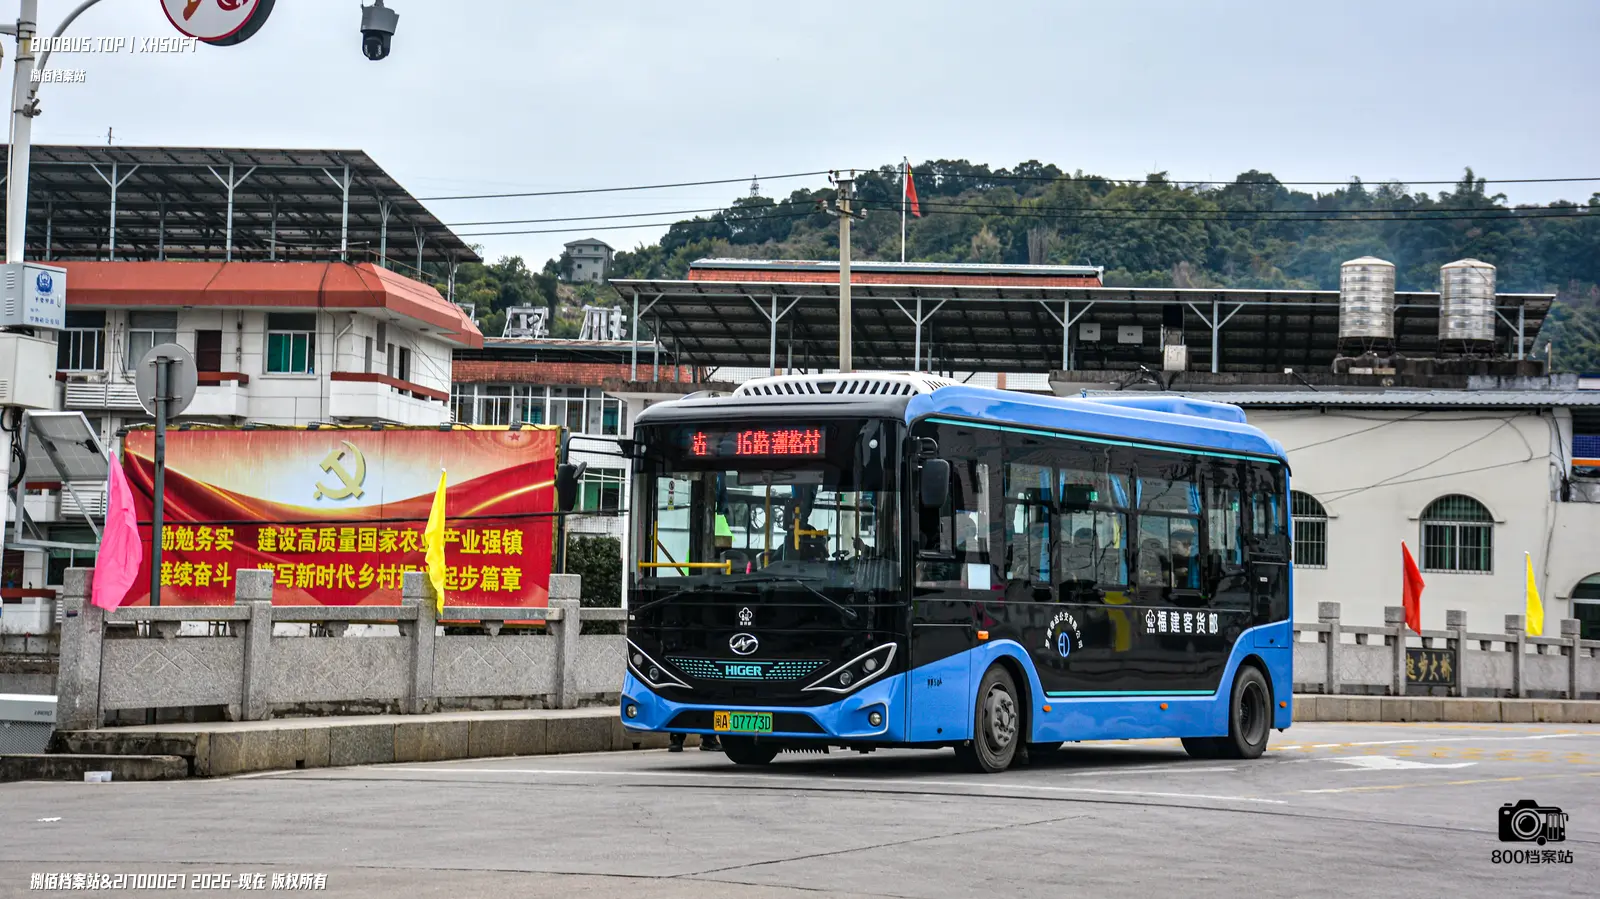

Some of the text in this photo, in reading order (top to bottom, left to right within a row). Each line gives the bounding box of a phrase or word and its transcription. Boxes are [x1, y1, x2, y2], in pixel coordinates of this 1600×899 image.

[257, 562, 523, 593] 写新时代乡村起步篇章
[1157, 610, 1219, 634] 福建客货邮
[725, 665, 763, 676] HIGER
